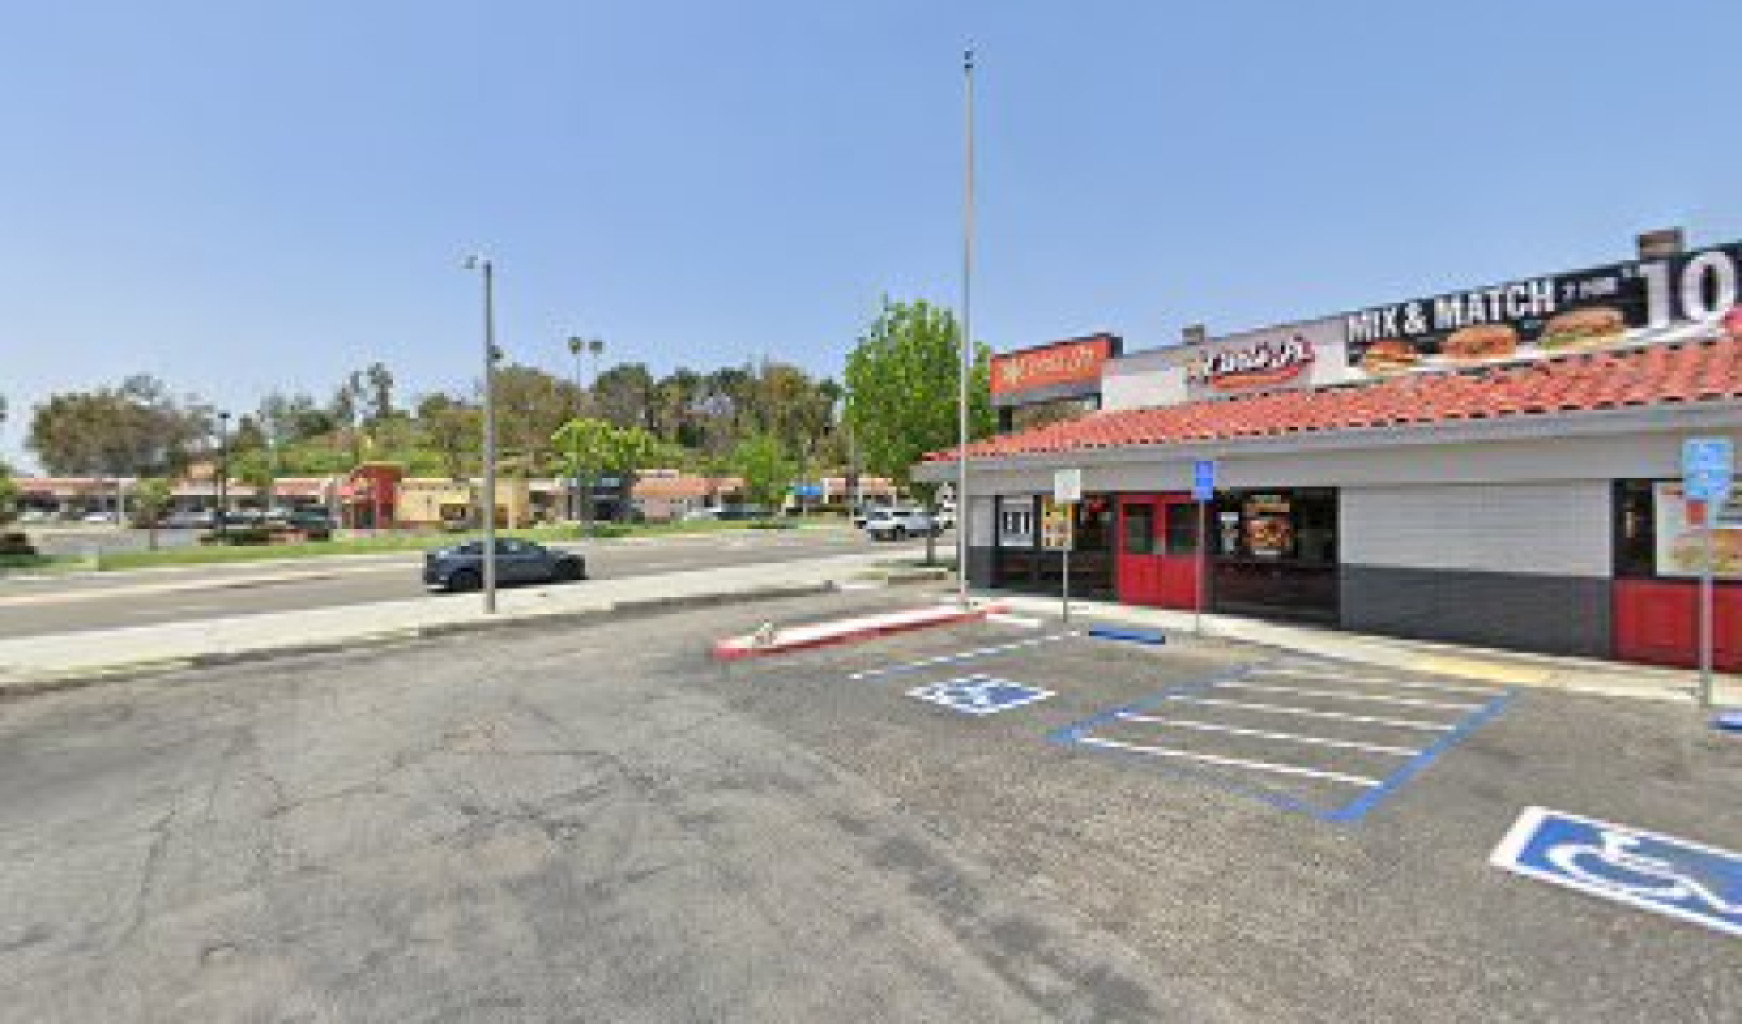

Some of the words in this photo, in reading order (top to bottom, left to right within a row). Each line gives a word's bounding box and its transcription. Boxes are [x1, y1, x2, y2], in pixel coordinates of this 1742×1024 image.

[1347, 308, 1399, 343] MIX
[1404, 302, 1427, 334] &
[1433, 279, 1554, 330] MATCH
